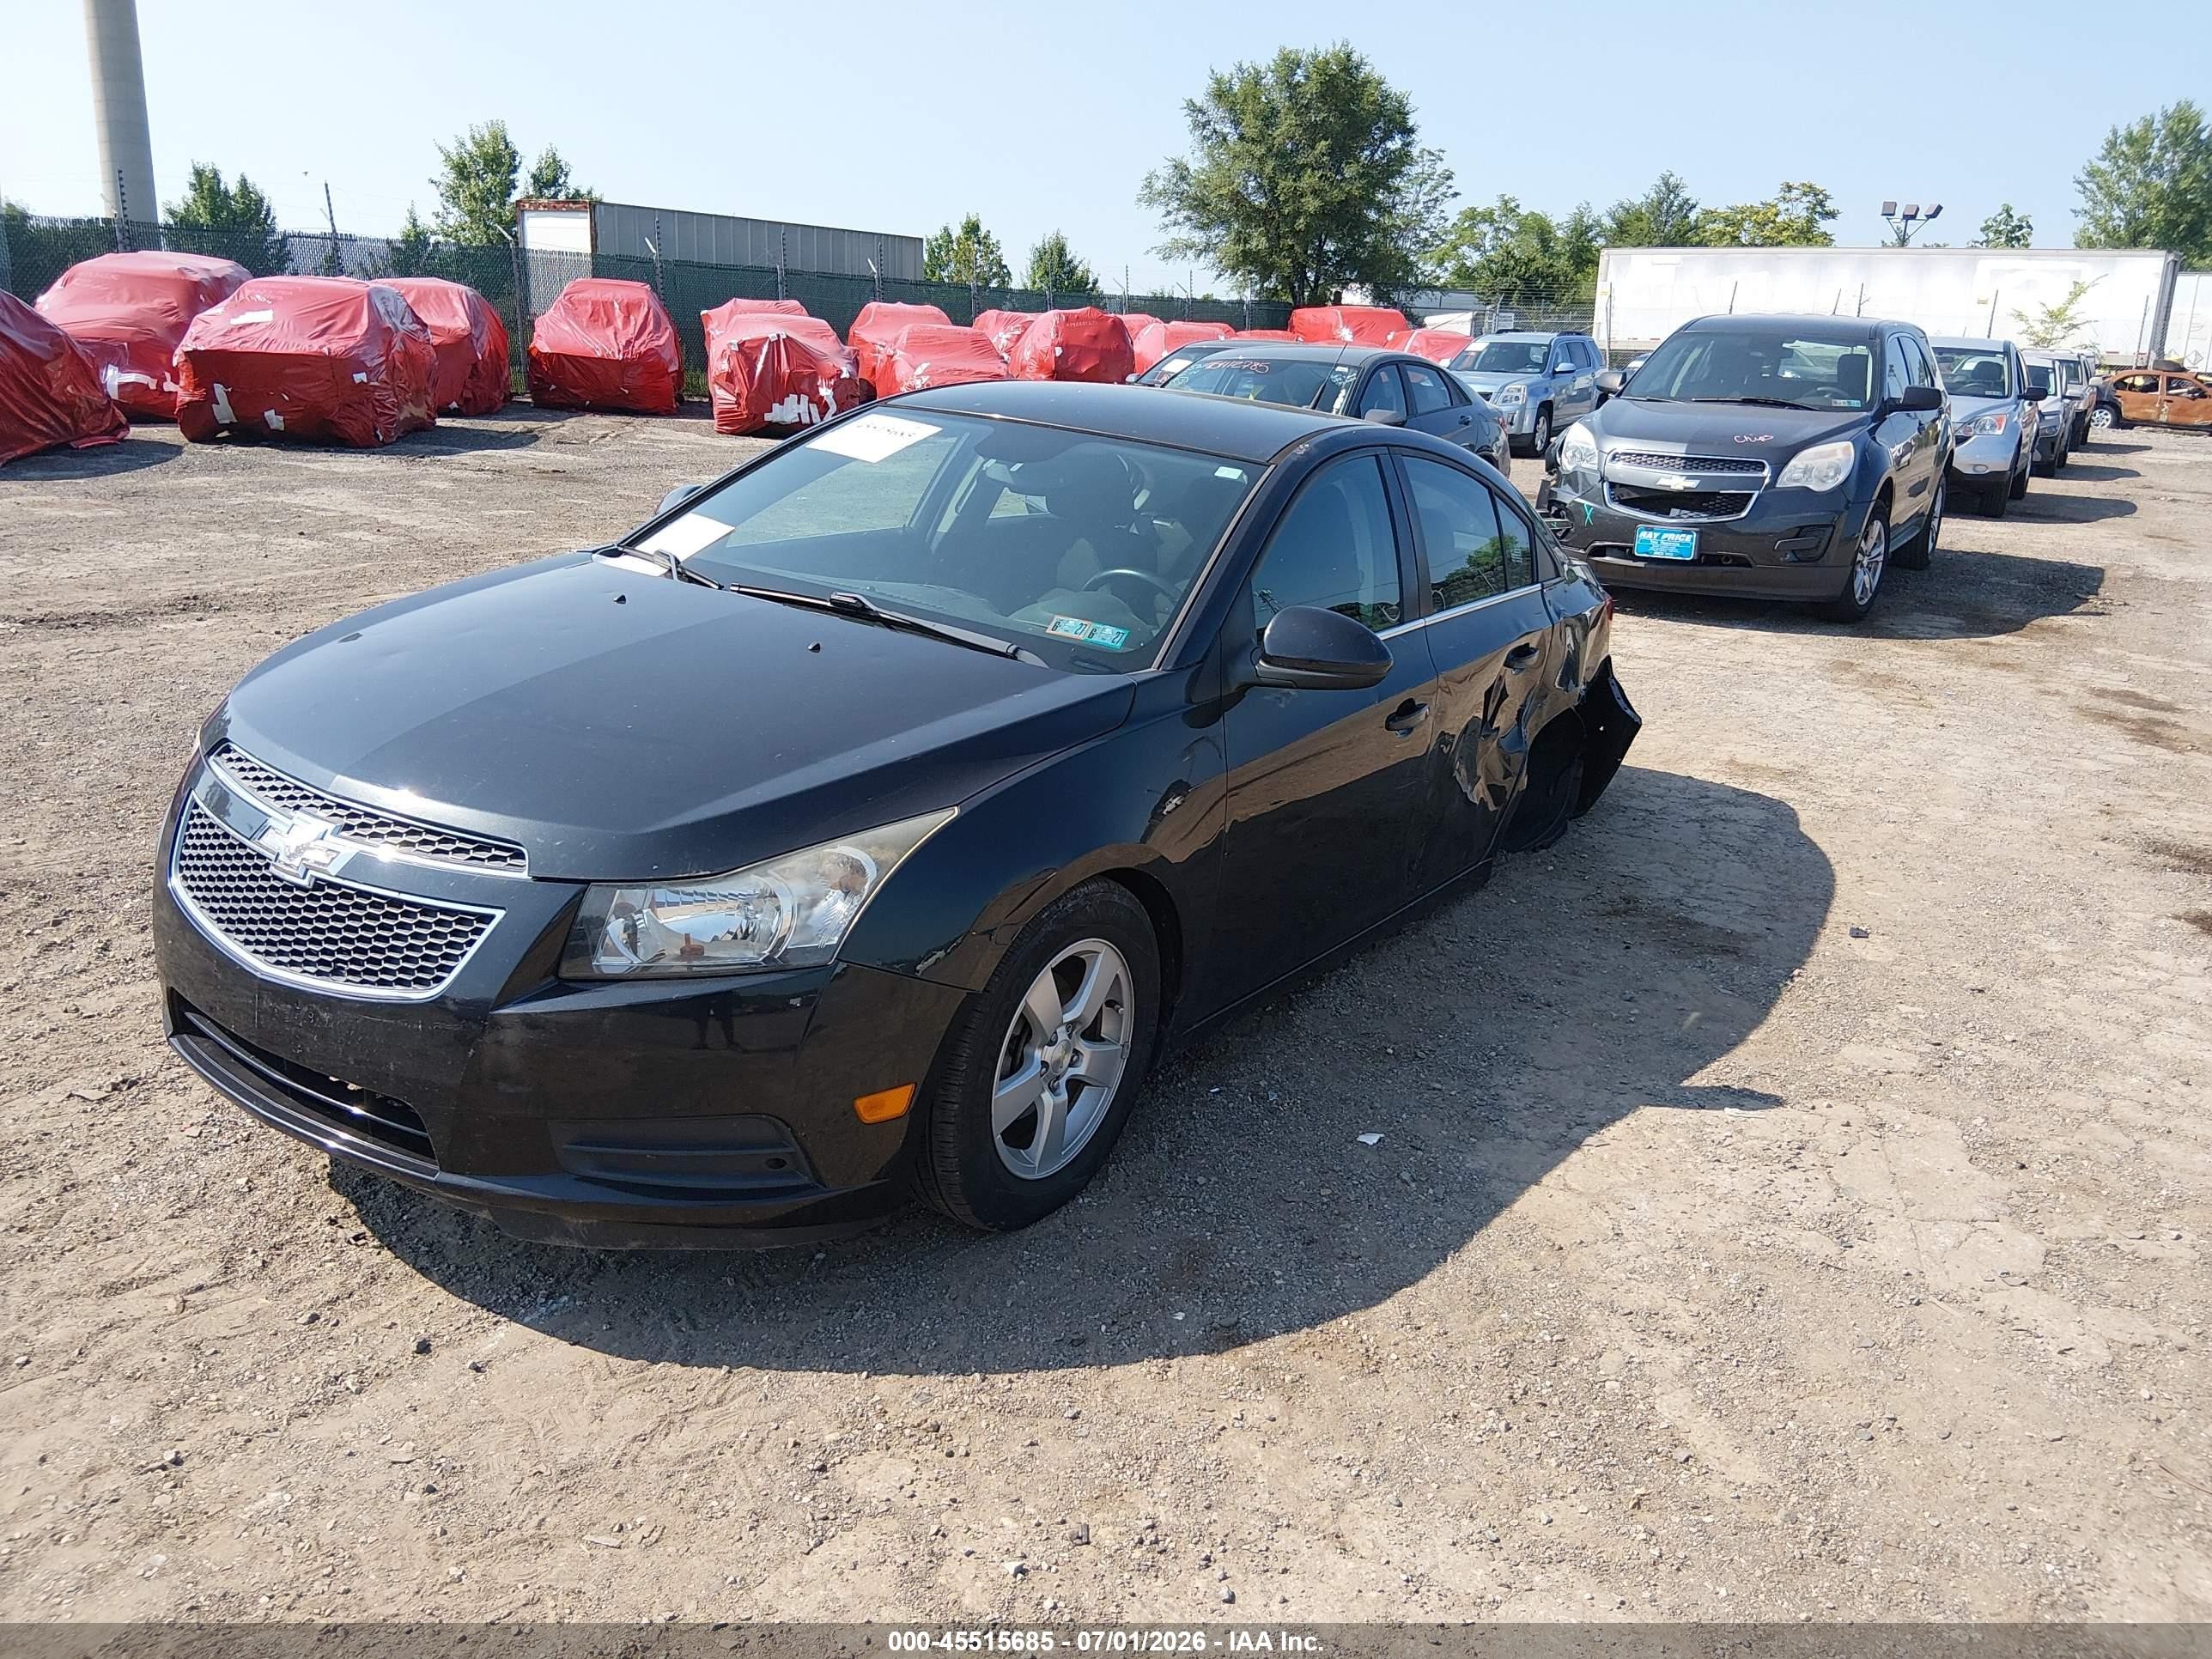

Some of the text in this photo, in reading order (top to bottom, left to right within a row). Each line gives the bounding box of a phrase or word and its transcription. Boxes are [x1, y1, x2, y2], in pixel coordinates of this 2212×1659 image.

[1660, 532, 1693, 542] PRICE
[1051, 621, 1061, 632] 6
[1074, 623, 1088, 636] 27
[1087, 628, 1097, 639] 6
[1111, 631, 1125, 645] 27
